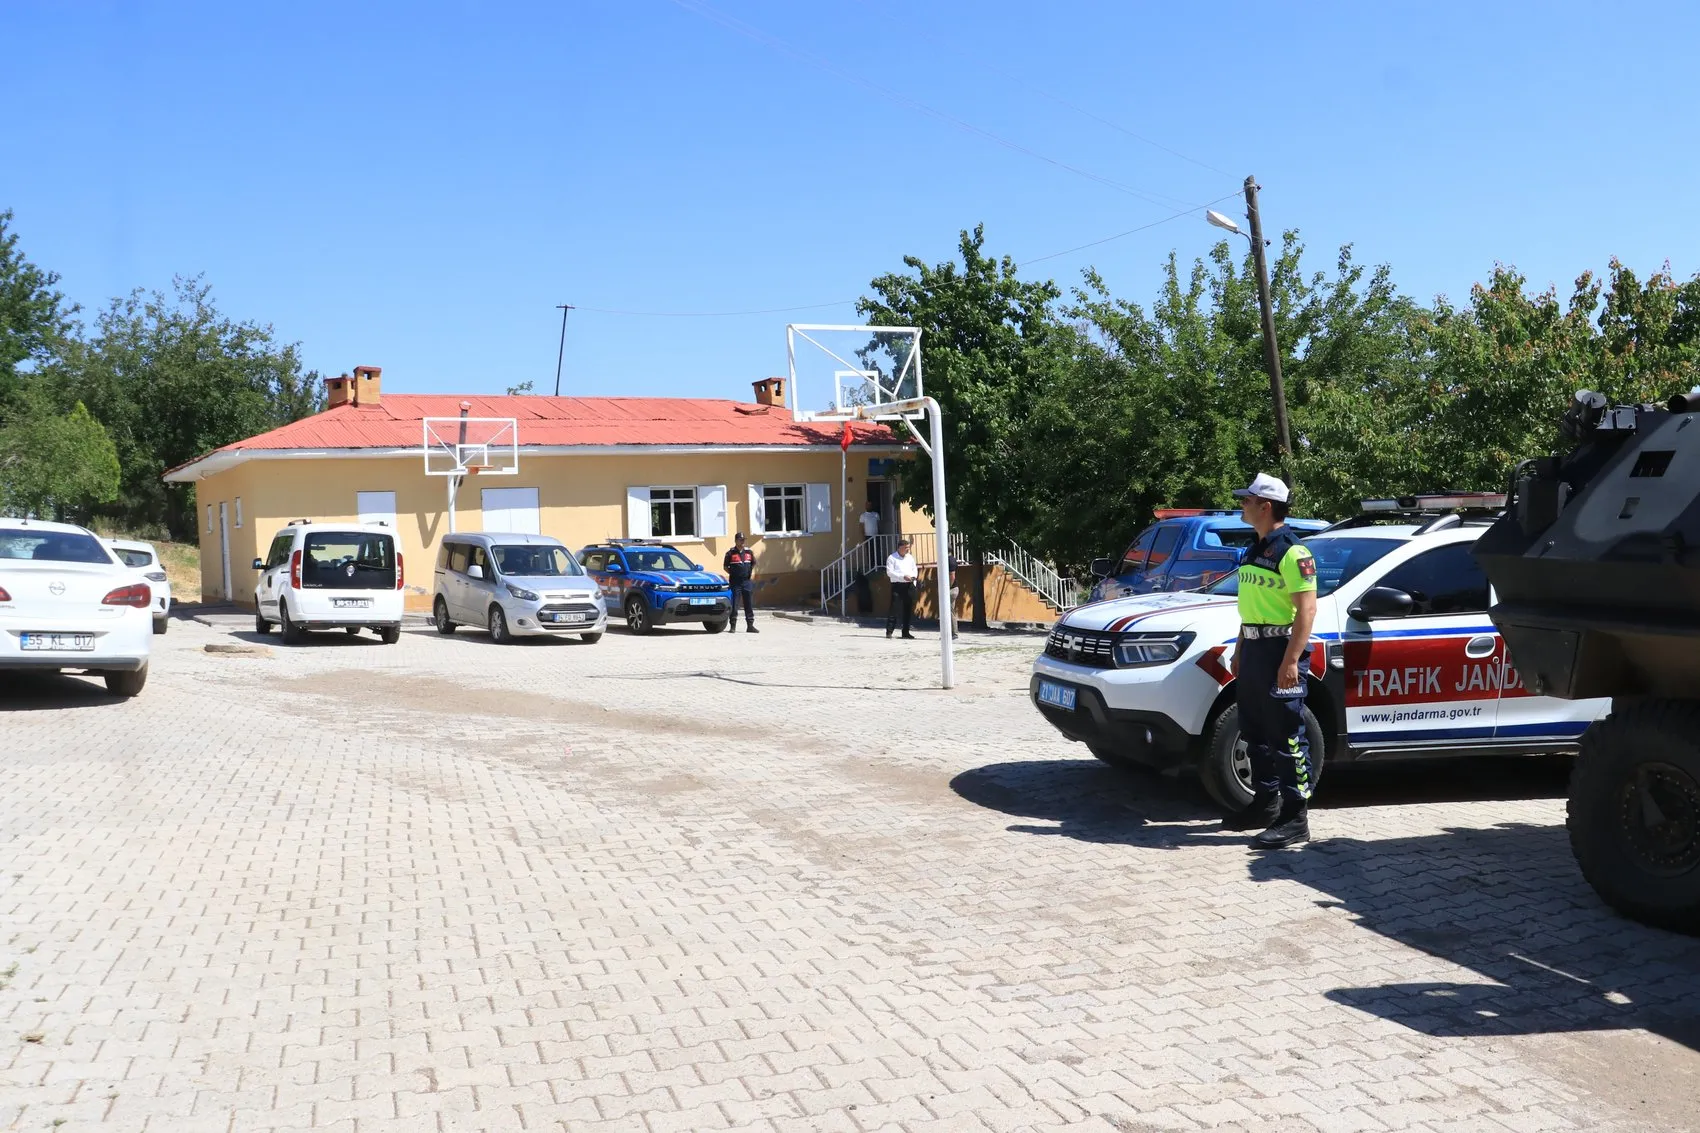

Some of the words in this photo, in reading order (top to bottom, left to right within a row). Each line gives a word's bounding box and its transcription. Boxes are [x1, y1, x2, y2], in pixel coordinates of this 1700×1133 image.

[28, 634, 43, 646] 55
[50, 634, 65, 646] KL
[74, 634, 93, 647] 017
[1455, 663, 1524, 691] JAND
[1063, 688, 1076, 707] 607
[1361, 706, 1482, 724] www.jandarma.gov.tr
